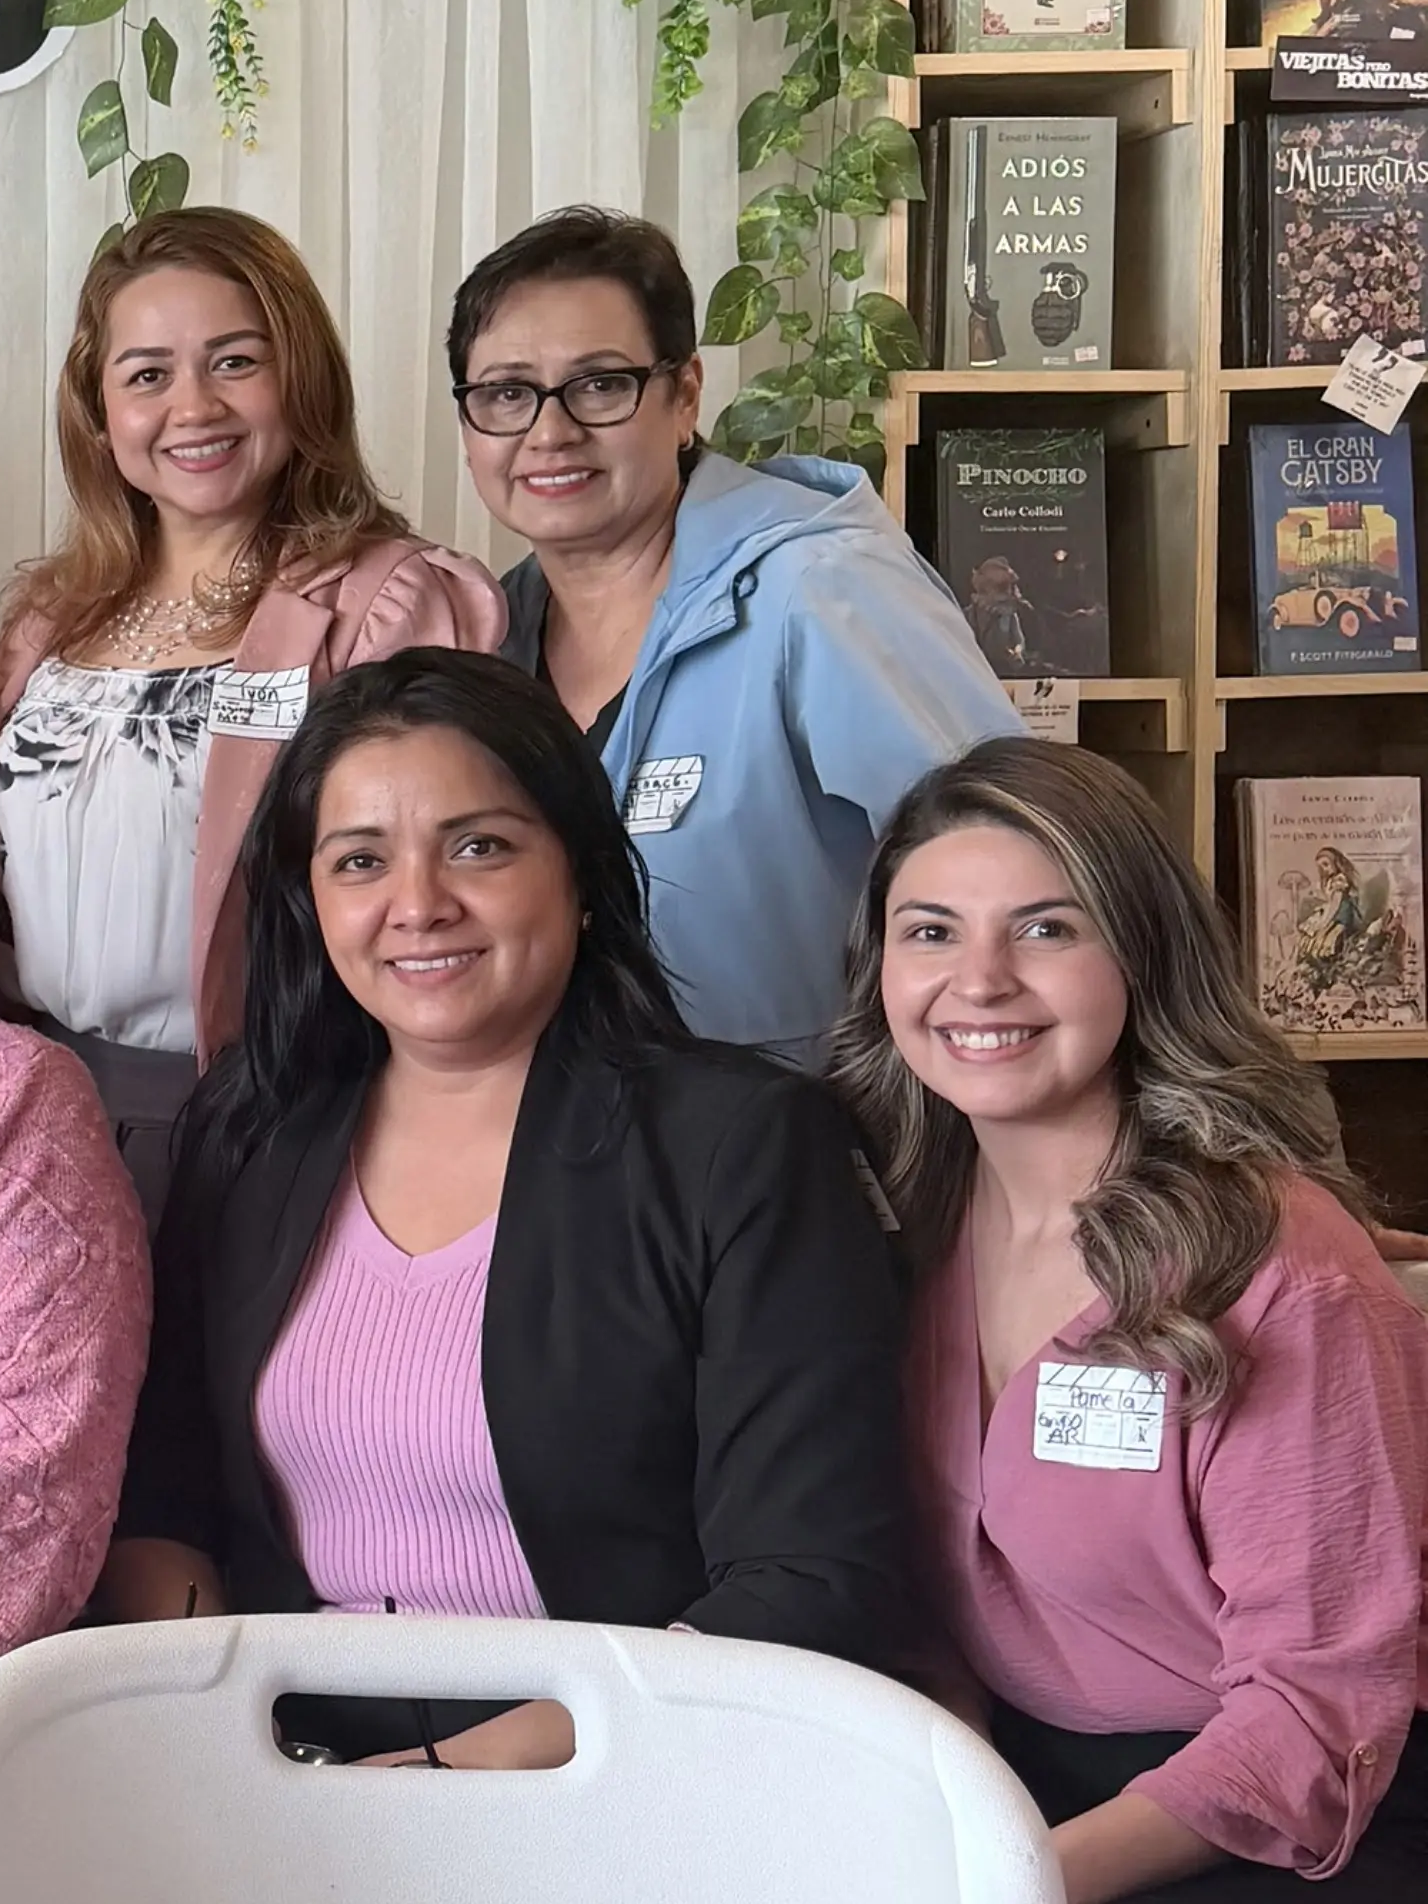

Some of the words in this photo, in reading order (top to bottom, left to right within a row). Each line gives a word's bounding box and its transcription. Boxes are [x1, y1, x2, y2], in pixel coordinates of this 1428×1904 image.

[1279, 52, 1366, 74] VIEJITAS
[1337, 72, 1428, 90] BONITAS
[1002, 154, 1086, 178] ADIÓS
[1275, 147, 1428, 195] MUJERCITAS
[1002, 196, 1020, 216] A
[1033, 196, 1082, 216] LAS
[995, 233, 1089, 254] ARMAS
[1287, 439, 1312, 459] EL
[1314, 437, 1375, 459] GRAN
[956, 463, 1088, 485] PINOCHO
[1280, 459, 1384, 487] GATSBY
[982, 506, 1016, 517] Carlo
